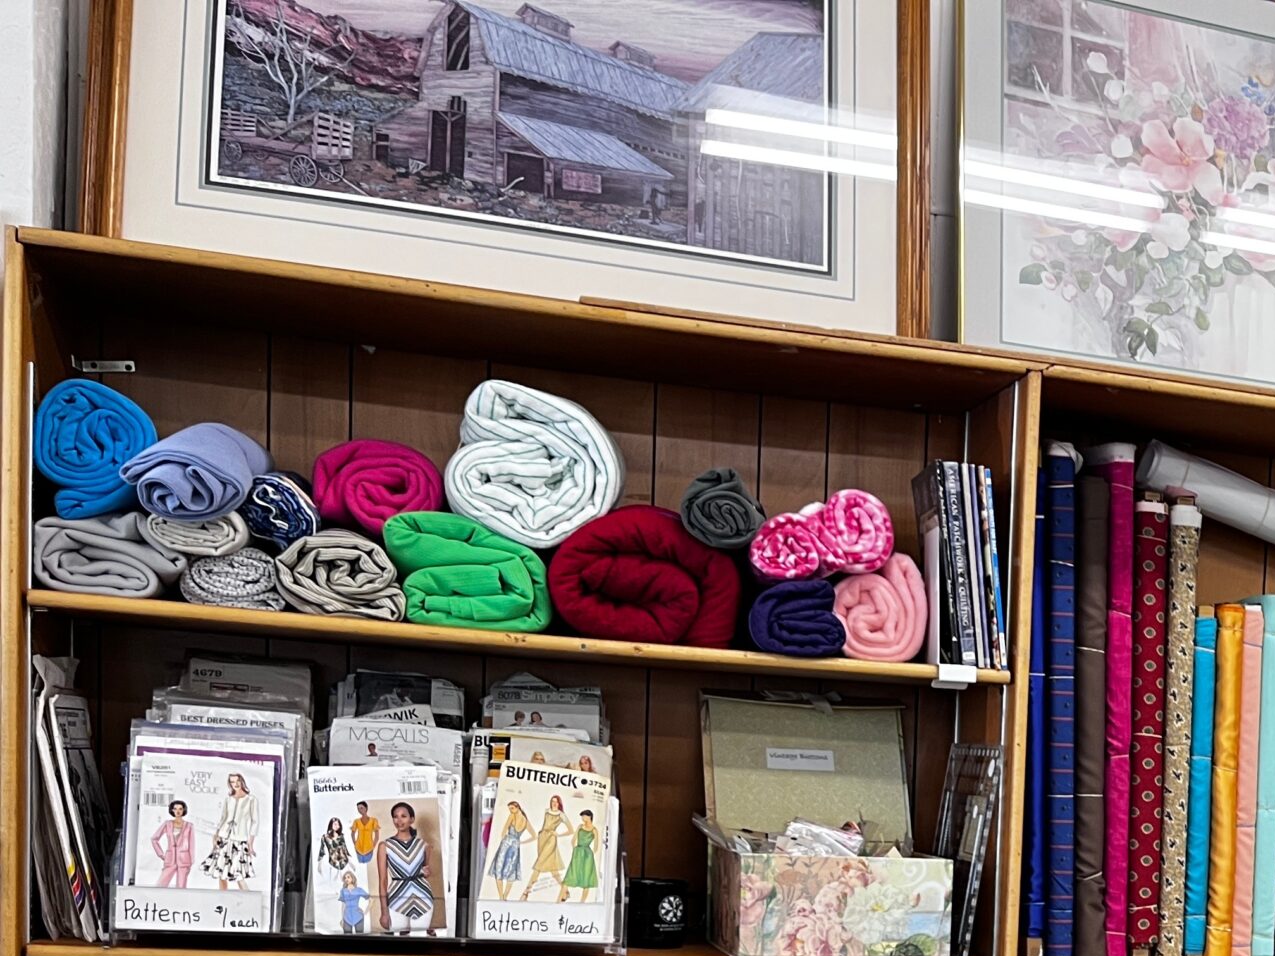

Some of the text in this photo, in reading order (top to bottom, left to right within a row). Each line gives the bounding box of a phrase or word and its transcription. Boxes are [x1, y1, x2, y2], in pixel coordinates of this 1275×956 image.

[950, 469, 958, 516] AMERICAN
[952, 521, 964, 575] PATCHWORK
[958, 586, 969, 626] QUILTING
[180, 714, 284, 728] BEST DRESSED PURSES
[184, 778, 206, 786] EASY
[191, 770, 212, 779] VERY
[506, 766, 578, 789] BUTTERICK
[190, 786, 218, 794] VOGUE
[314, 784, 354, 793] Butterick
[124, 899, 200, 922] Patterns
[482, 910, 548, 934] Patterns
